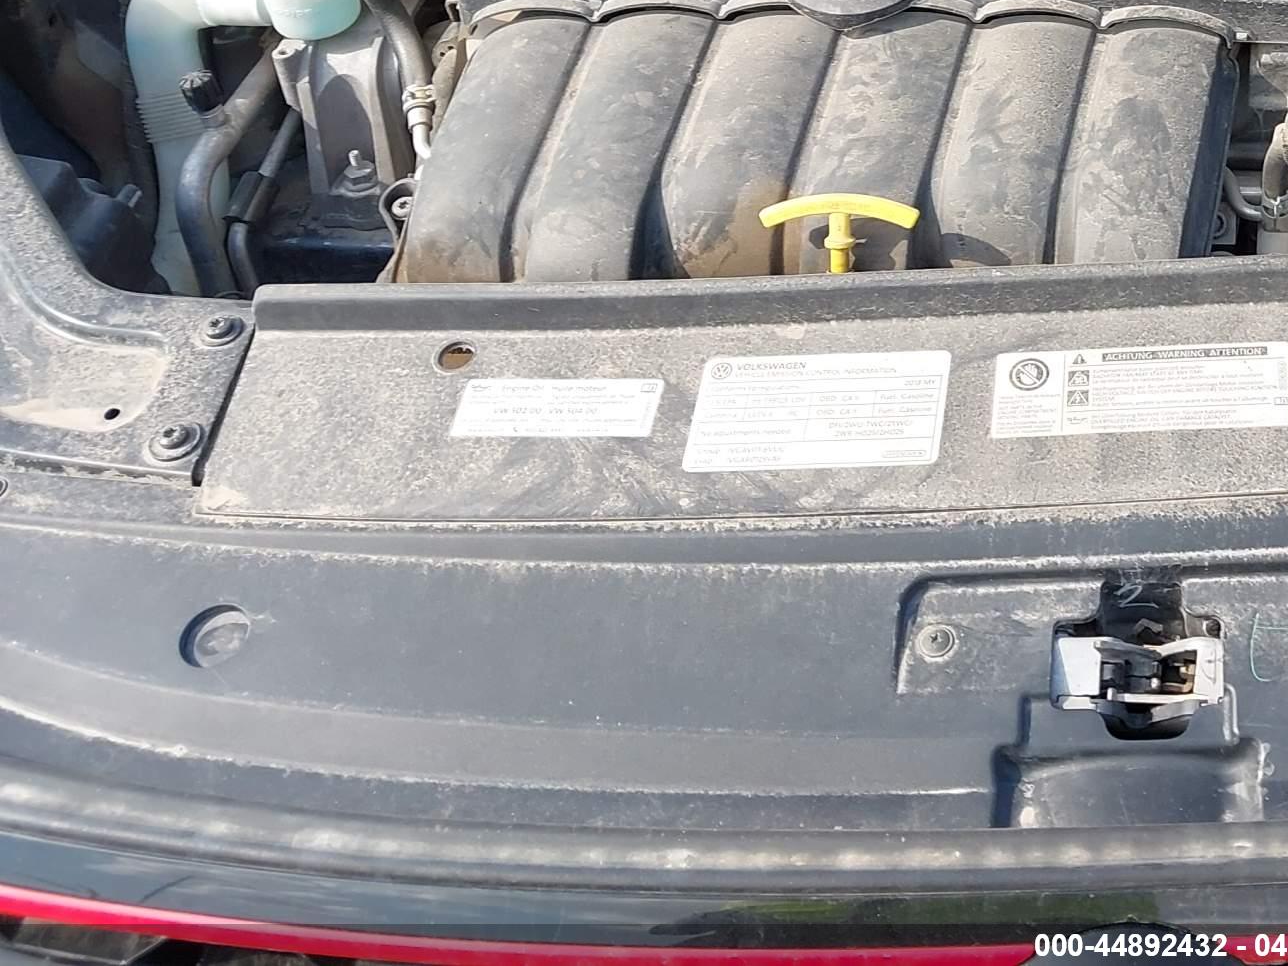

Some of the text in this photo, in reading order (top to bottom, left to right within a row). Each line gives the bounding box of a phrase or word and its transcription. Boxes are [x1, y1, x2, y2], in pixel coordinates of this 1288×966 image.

[1105, 347, 1262, 361] ACHTUNG WARNING ATTENTION
[736, 361, 807, 371] VOLKSWAGEN
